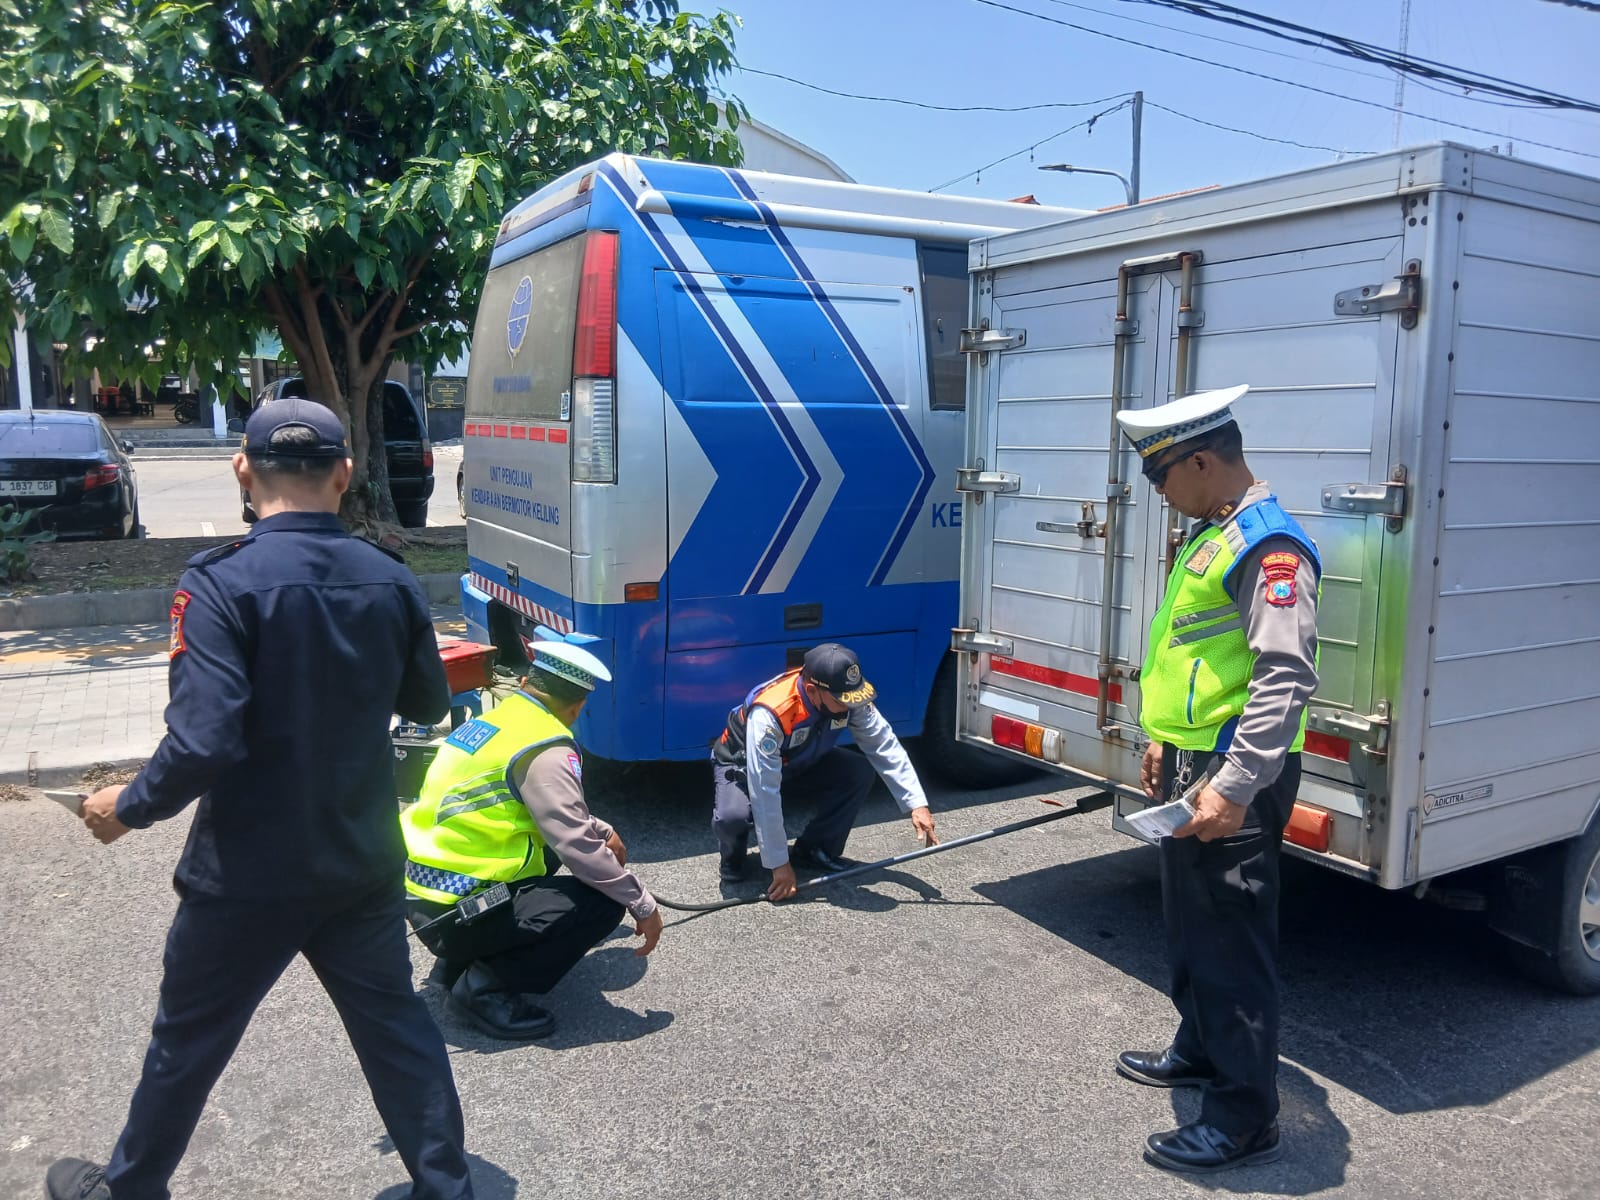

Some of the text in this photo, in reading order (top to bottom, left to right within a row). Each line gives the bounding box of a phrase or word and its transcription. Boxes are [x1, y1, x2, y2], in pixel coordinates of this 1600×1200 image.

[490, 465, 533, 490] UNIT PENGUJIAN
[471, 488, 560, 525] KENDARAAN BERMOTOR KELILING
[454, 721, 491, 750] OLISI
